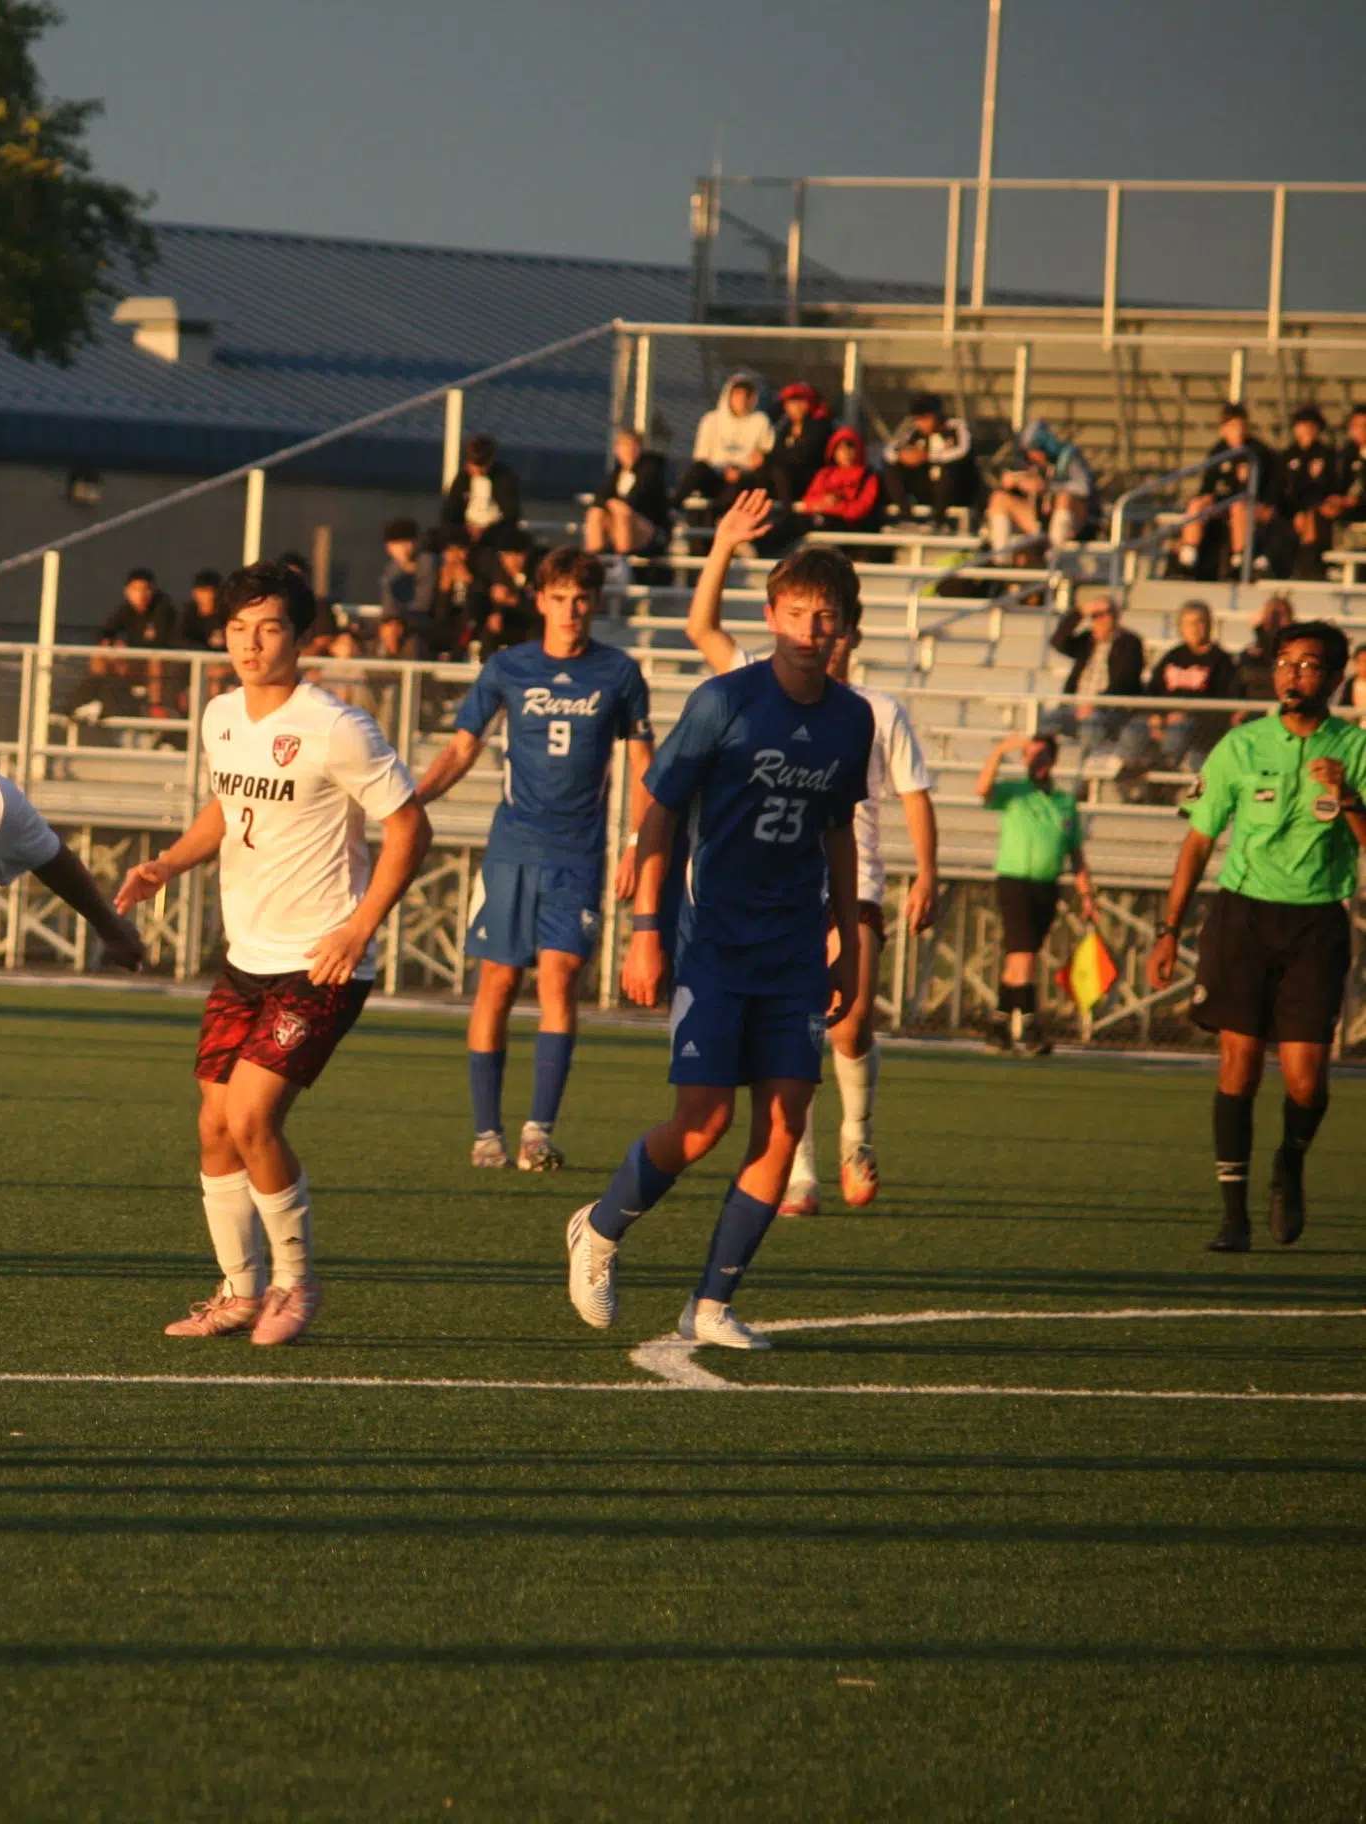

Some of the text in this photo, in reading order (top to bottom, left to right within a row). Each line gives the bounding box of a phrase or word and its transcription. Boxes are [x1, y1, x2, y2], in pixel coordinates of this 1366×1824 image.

[521, 687, 601, 716] Rural
[548, 720, 571, 756] 9
[214, 771, 295, 802] MPORIA
[747, 748, 840, 792] Rural
[241, 806, 255, 850] 2
[753, 795, 808, 843] 23
